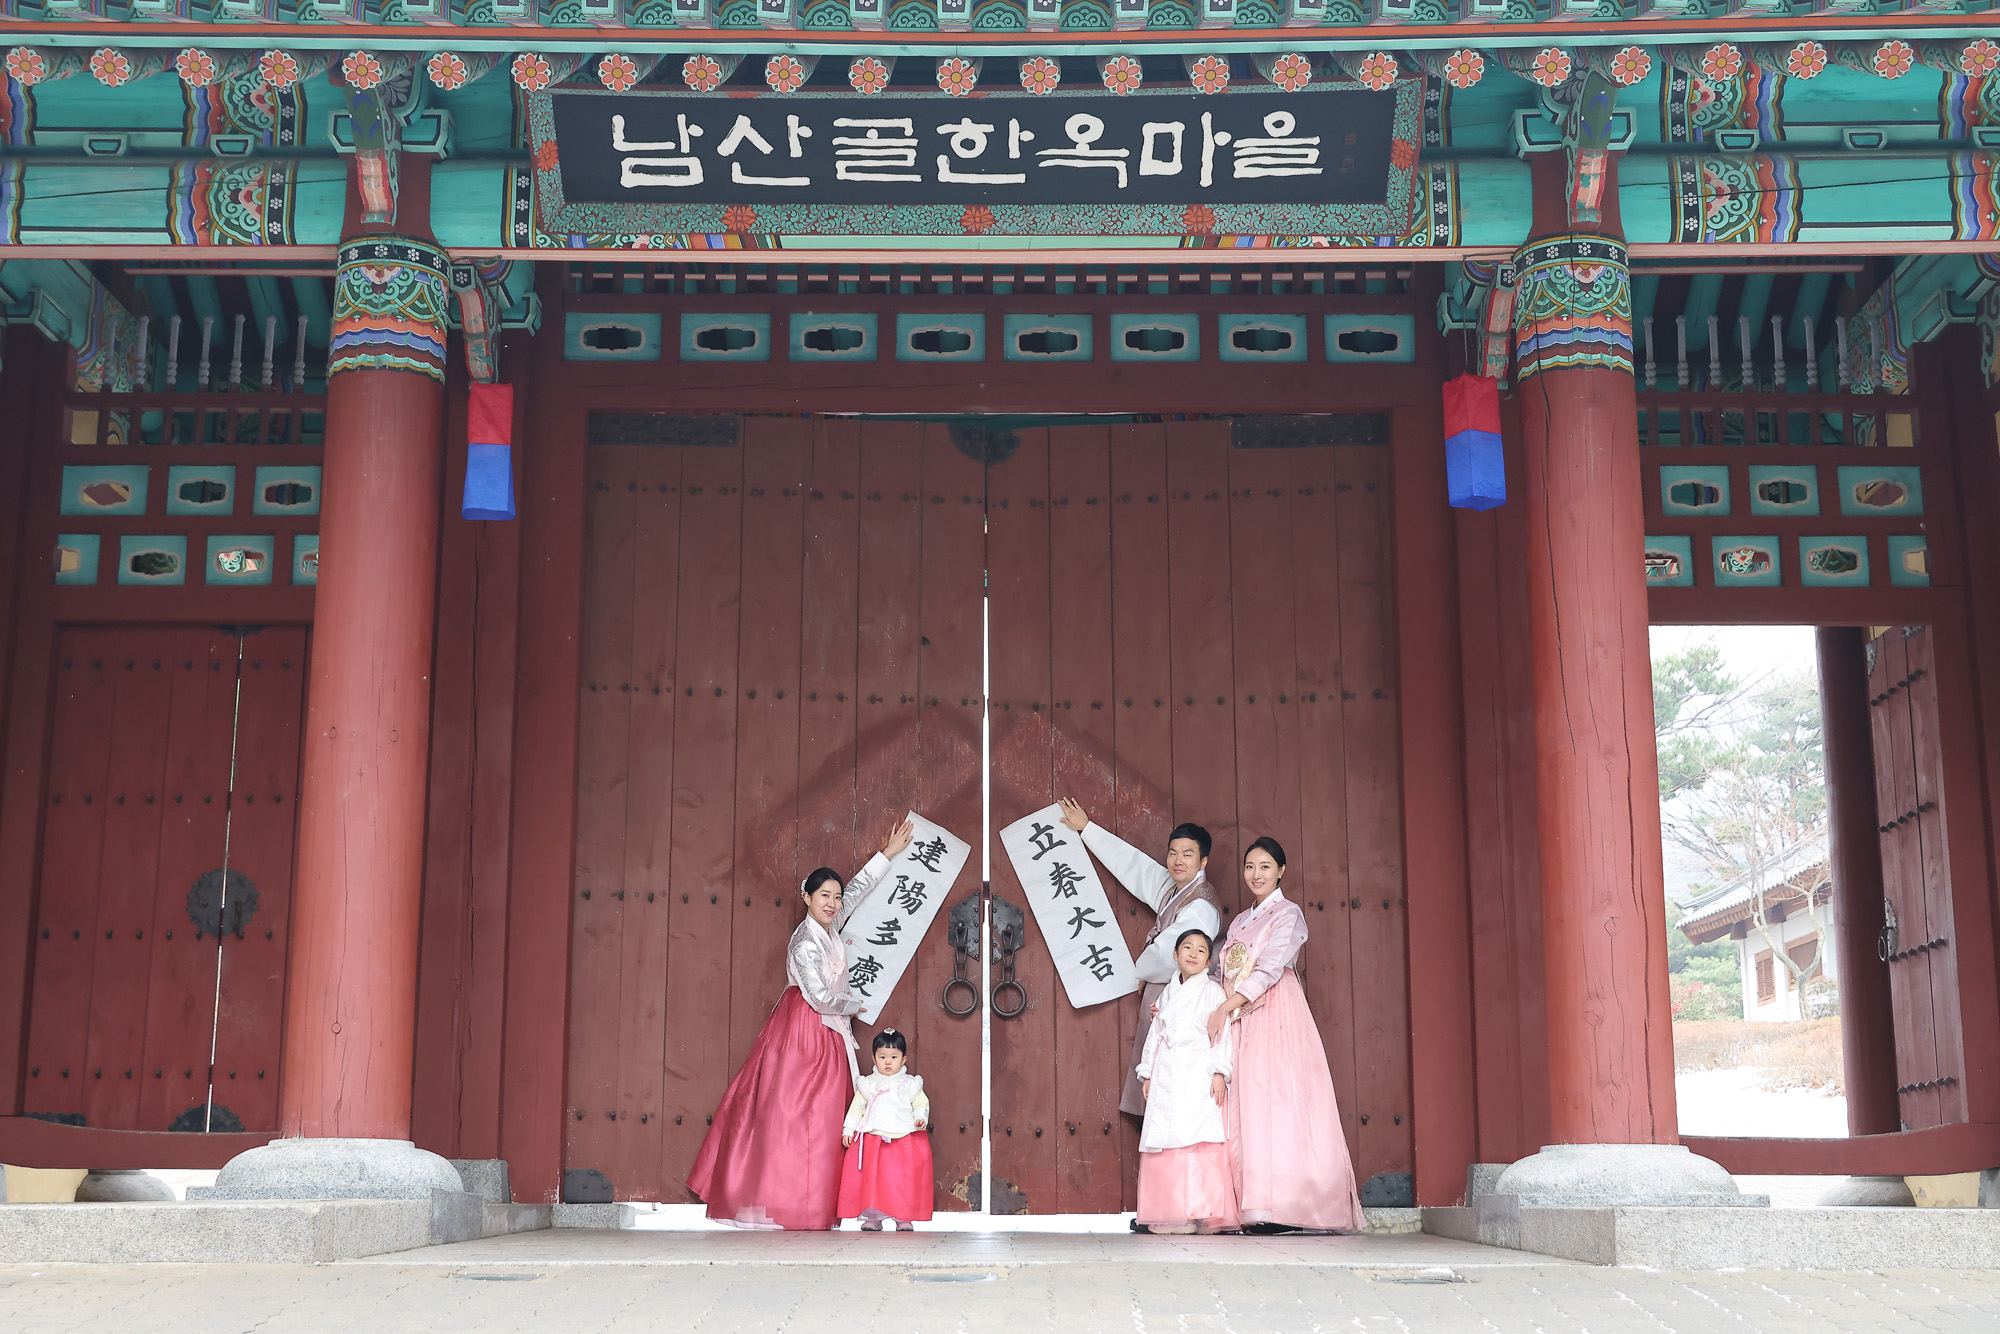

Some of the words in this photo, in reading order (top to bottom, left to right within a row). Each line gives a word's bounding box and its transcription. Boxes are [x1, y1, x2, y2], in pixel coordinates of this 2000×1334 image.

[612, 111, 1323, 188] 남산골한옥마을
[848, 836, 948, 997] 建陽多慶
[1028, 822, 1115, 982] 立春大吉
